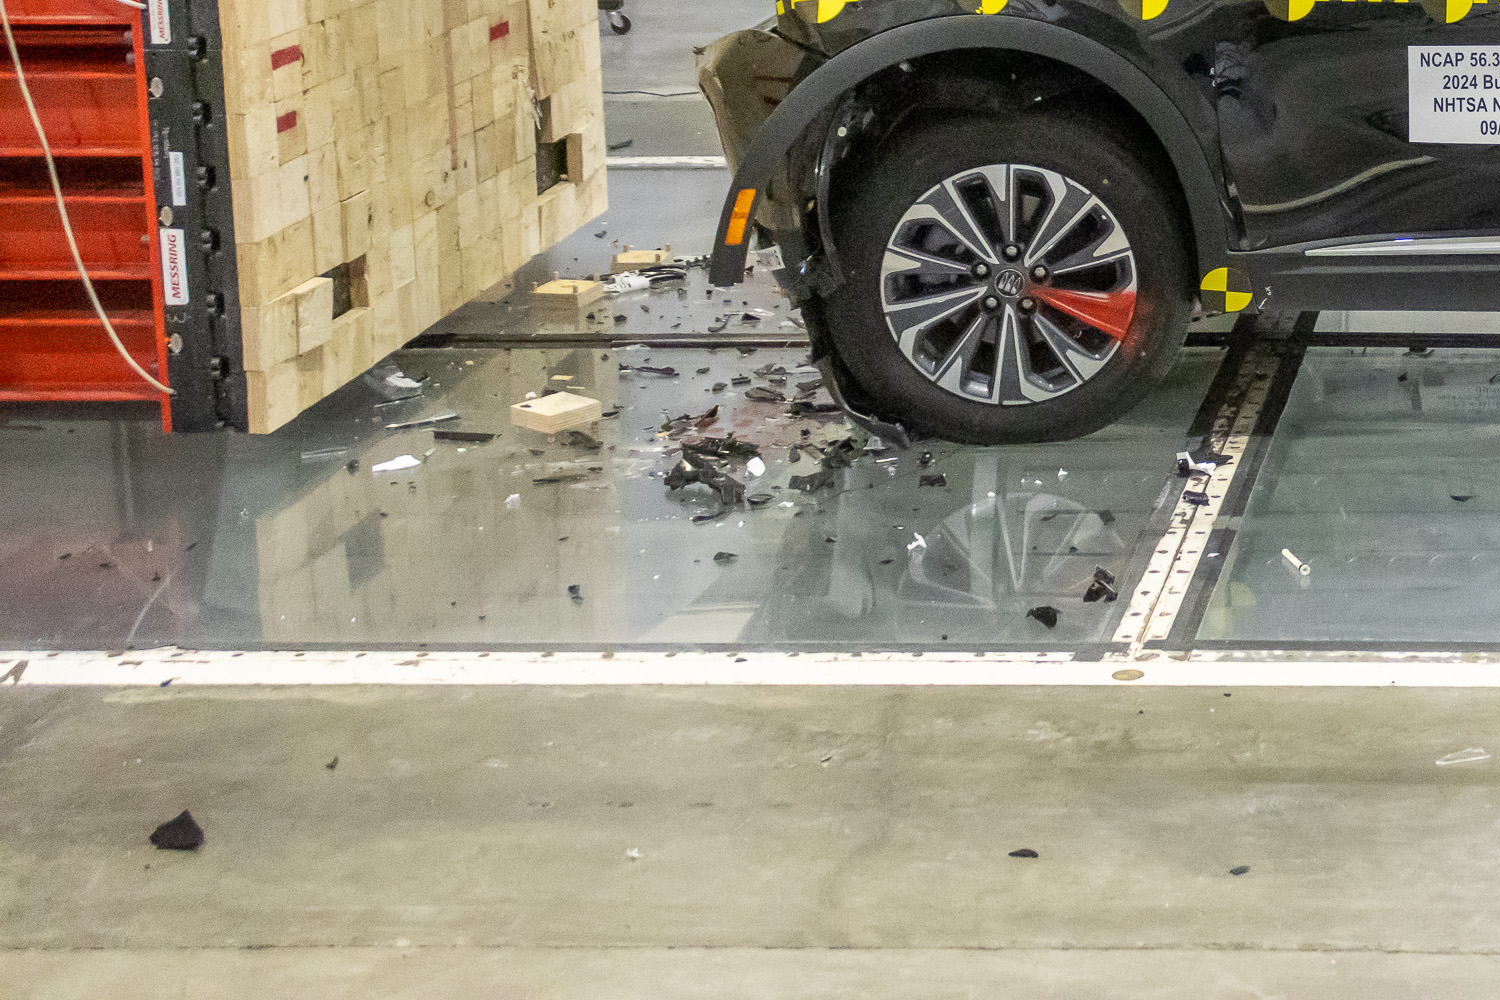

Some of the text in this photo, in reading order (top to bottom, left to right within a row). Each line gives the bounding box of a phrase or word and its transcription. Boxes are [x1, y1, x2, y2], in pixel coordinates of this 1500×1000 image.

[1420, 52, 1464, 67] NCAP
[1470, 52, 1500, 67] 56.3
[1442, 75, 1478, 90] 2024
[1434, 98, 1488, 112] NHTSA
[162, 233, 182, 300] MESSRING
